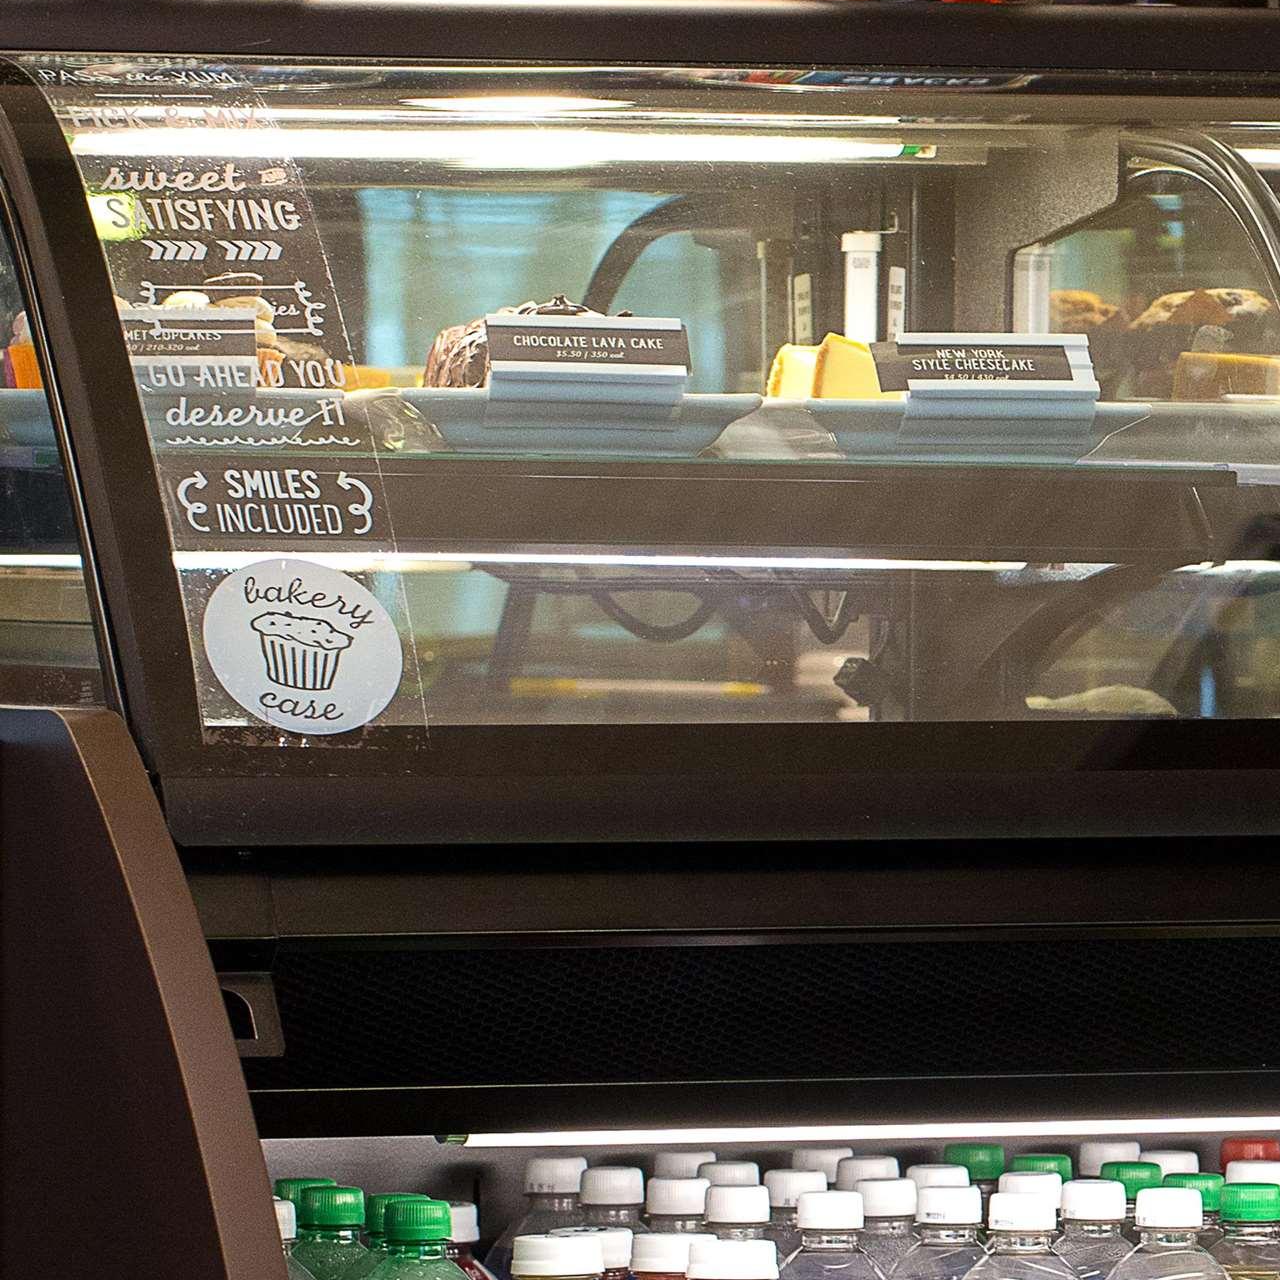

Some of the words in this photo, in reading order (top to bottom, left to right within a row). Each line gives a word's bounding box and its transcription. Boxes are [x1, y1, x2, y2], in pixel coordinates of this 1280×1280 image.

[37, 69, 114, 86] PASS
[170, 70, 238, 86] YUM
[101, 165, 247, 192] sweet
[106, 196, 301, 232] SATISFYING
[513, 335, 588, 349] CHOCOLATE
[592, 337, 626, 349] LAVA
[630, 337, 664, 350] CAKE
[936, 348, 967, 360] NEW
[971, 349, 1006, 360] YORK
[149, 364, 185, 388] GO
[193, 360, 285, 388] AHEAD
[290, 358, 346, 388] YOU
[911, 359, 950, 371] STYLE
[955, 359, 1036, 372] CHEESECAKE
[165, 397, 311, 428] deserve
[316, 398, 346, 426] IT
[224, 469, 321, 499] SMILES
[216, 503, 343, 535] INCLUDED
[243, 576, 373, 629] bakery
[258, 690, 344, 722] case
